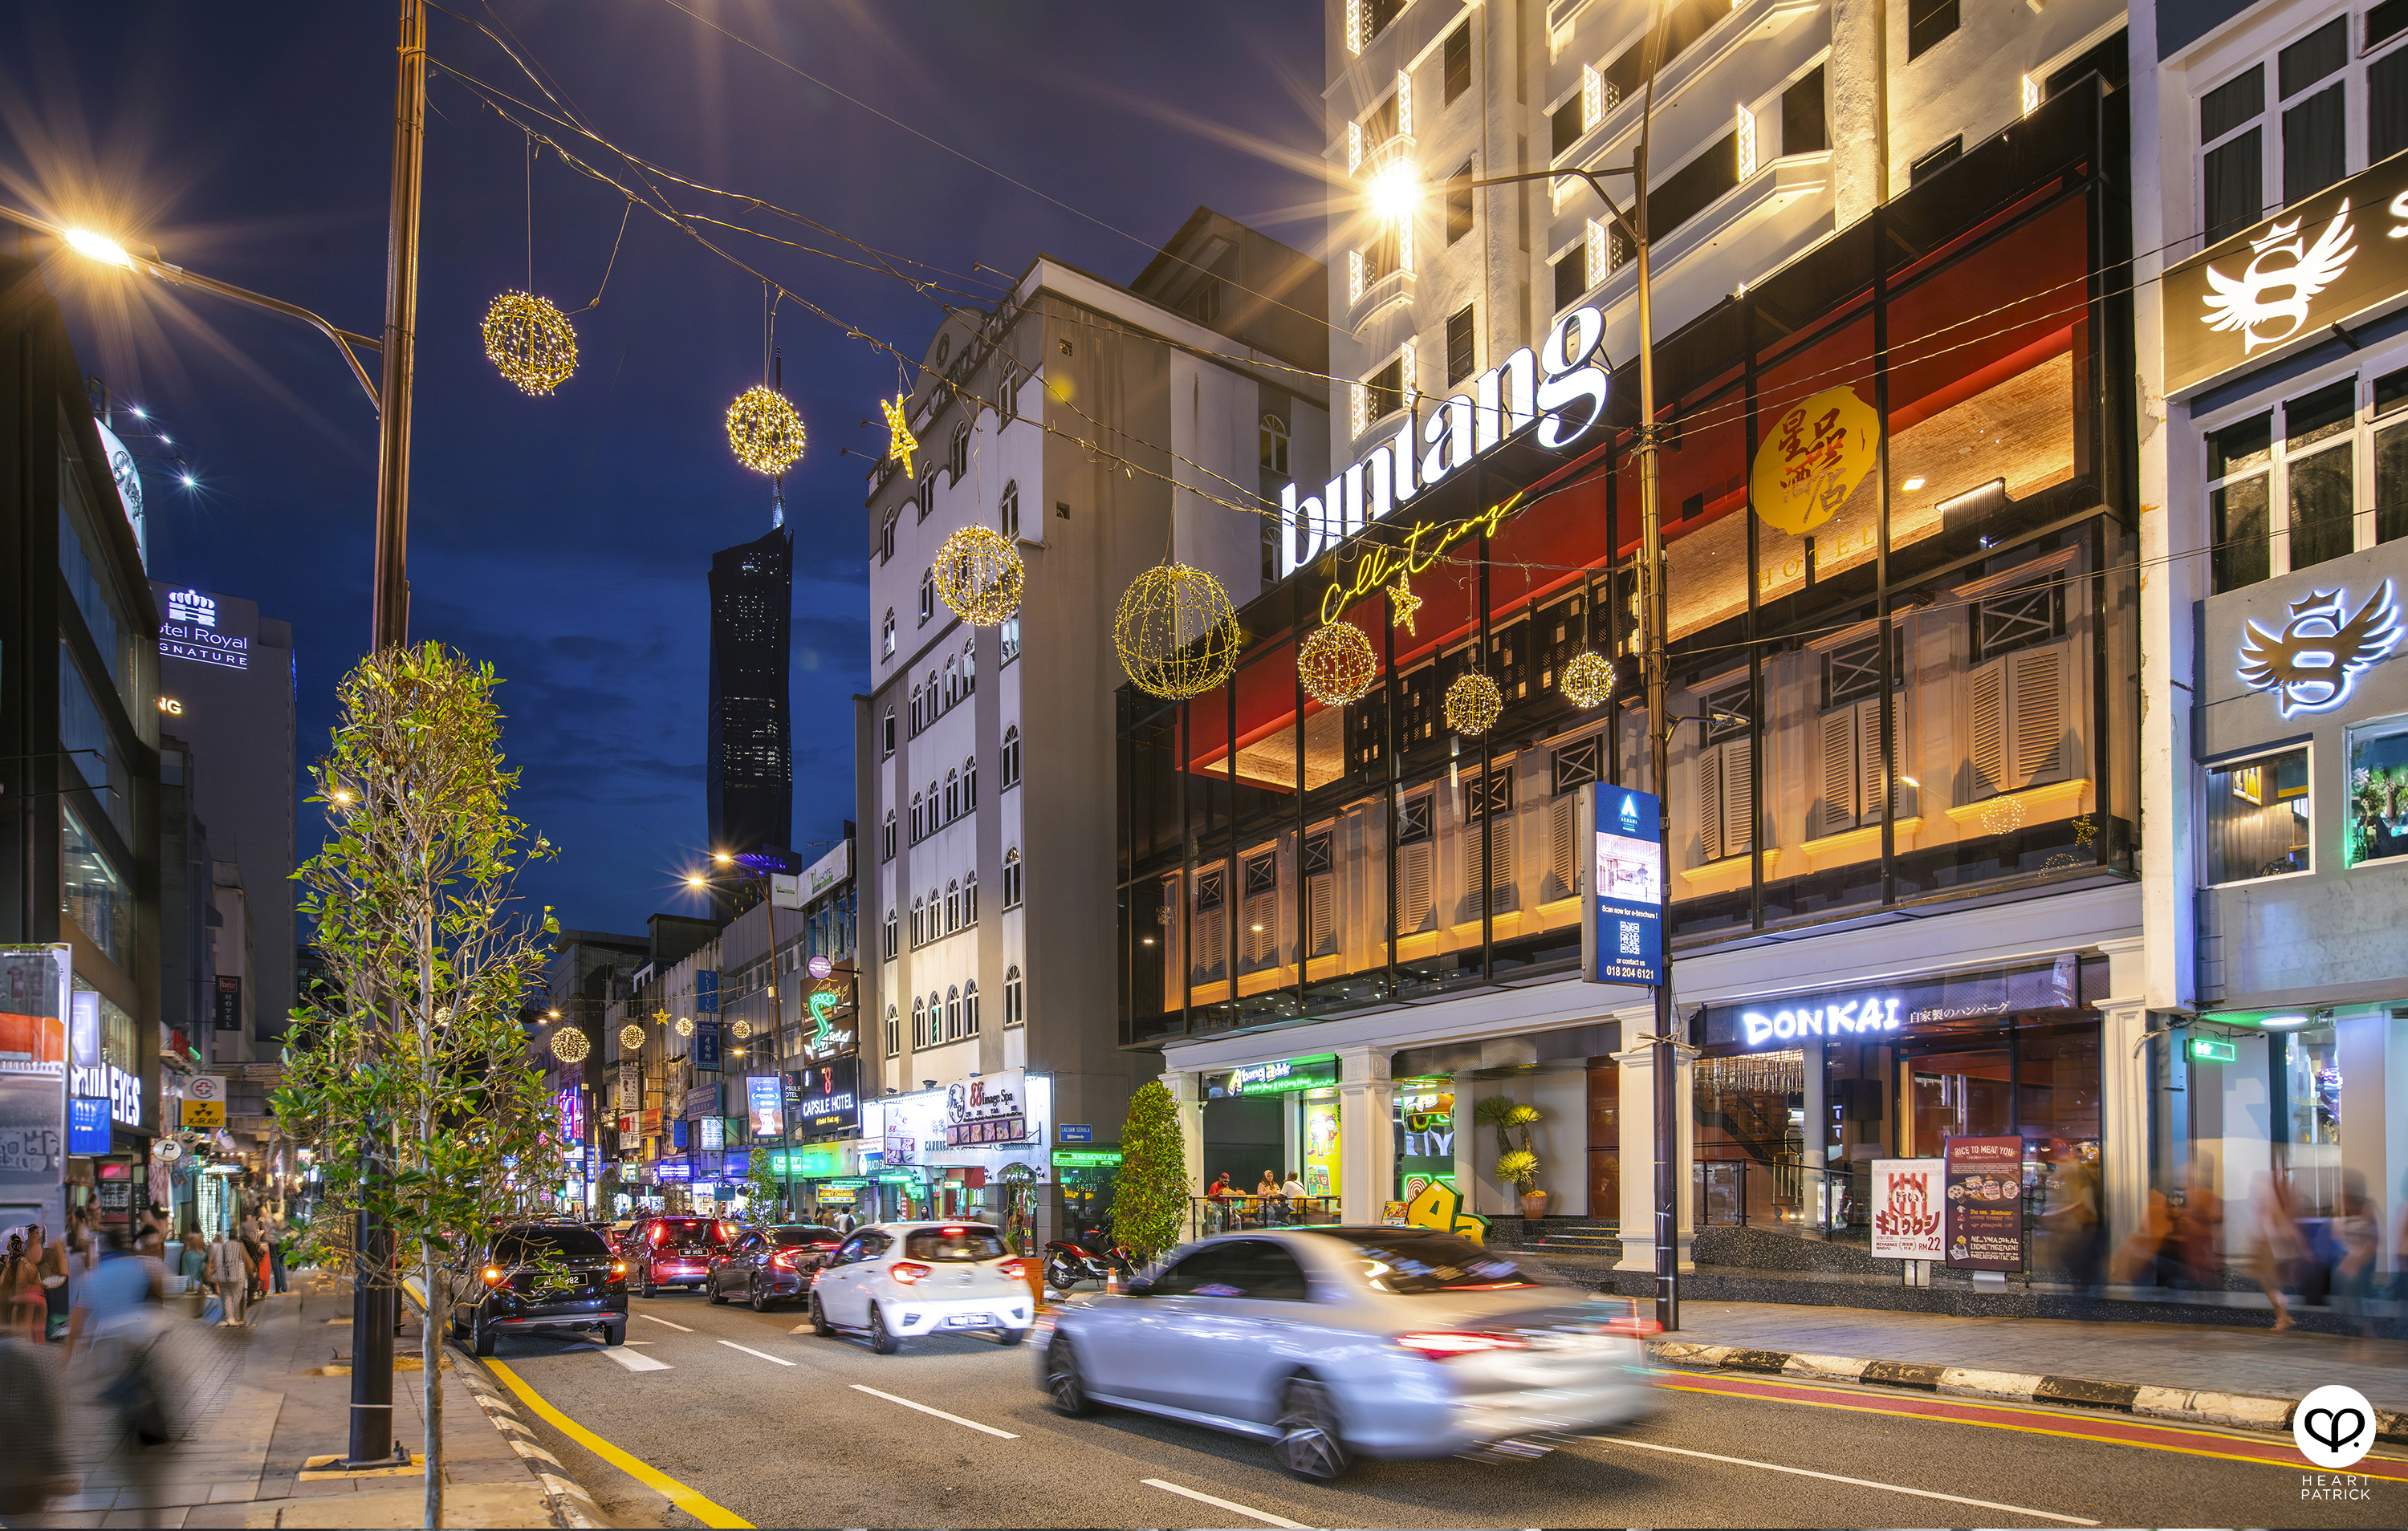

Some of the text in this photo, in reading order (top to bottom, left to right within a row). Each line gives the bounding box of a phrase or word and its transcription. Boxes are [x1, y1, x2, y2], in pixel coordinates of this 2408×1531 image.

[1756, 526, 1877, 592] HOTEL
[160, 622, 247, 650] tel Royal
[160, 642, 248, 666] GNATURE
[1601, 904, 1613, 913] Scan
[1631, 909, 1655, 920] e-brochure
[1606, 965, 1653, 980] 018 204 6121
[225, 994, 233, 1028] HOTEL
[1743, 997, 1900, 1046] DONKAI
[1910, 1000, 2010, 1024] 自家製のハンバーグ
[787, 1074, 793, 1086] 8
[825, 1066, 832, 1094] 8
[111, 1065, 141, 1127] EYES
[803, 1093, 854, 1117] CAPSULE HOTEL
[970, 1081, 1014, 1107] 88 Image Spa
[187, 1117, 221, 1125] X-RAY
[777, 1155, 799, 1163] MOEY
[1954, 1145, 2014, 1155] RICE TO MEAT YOU
